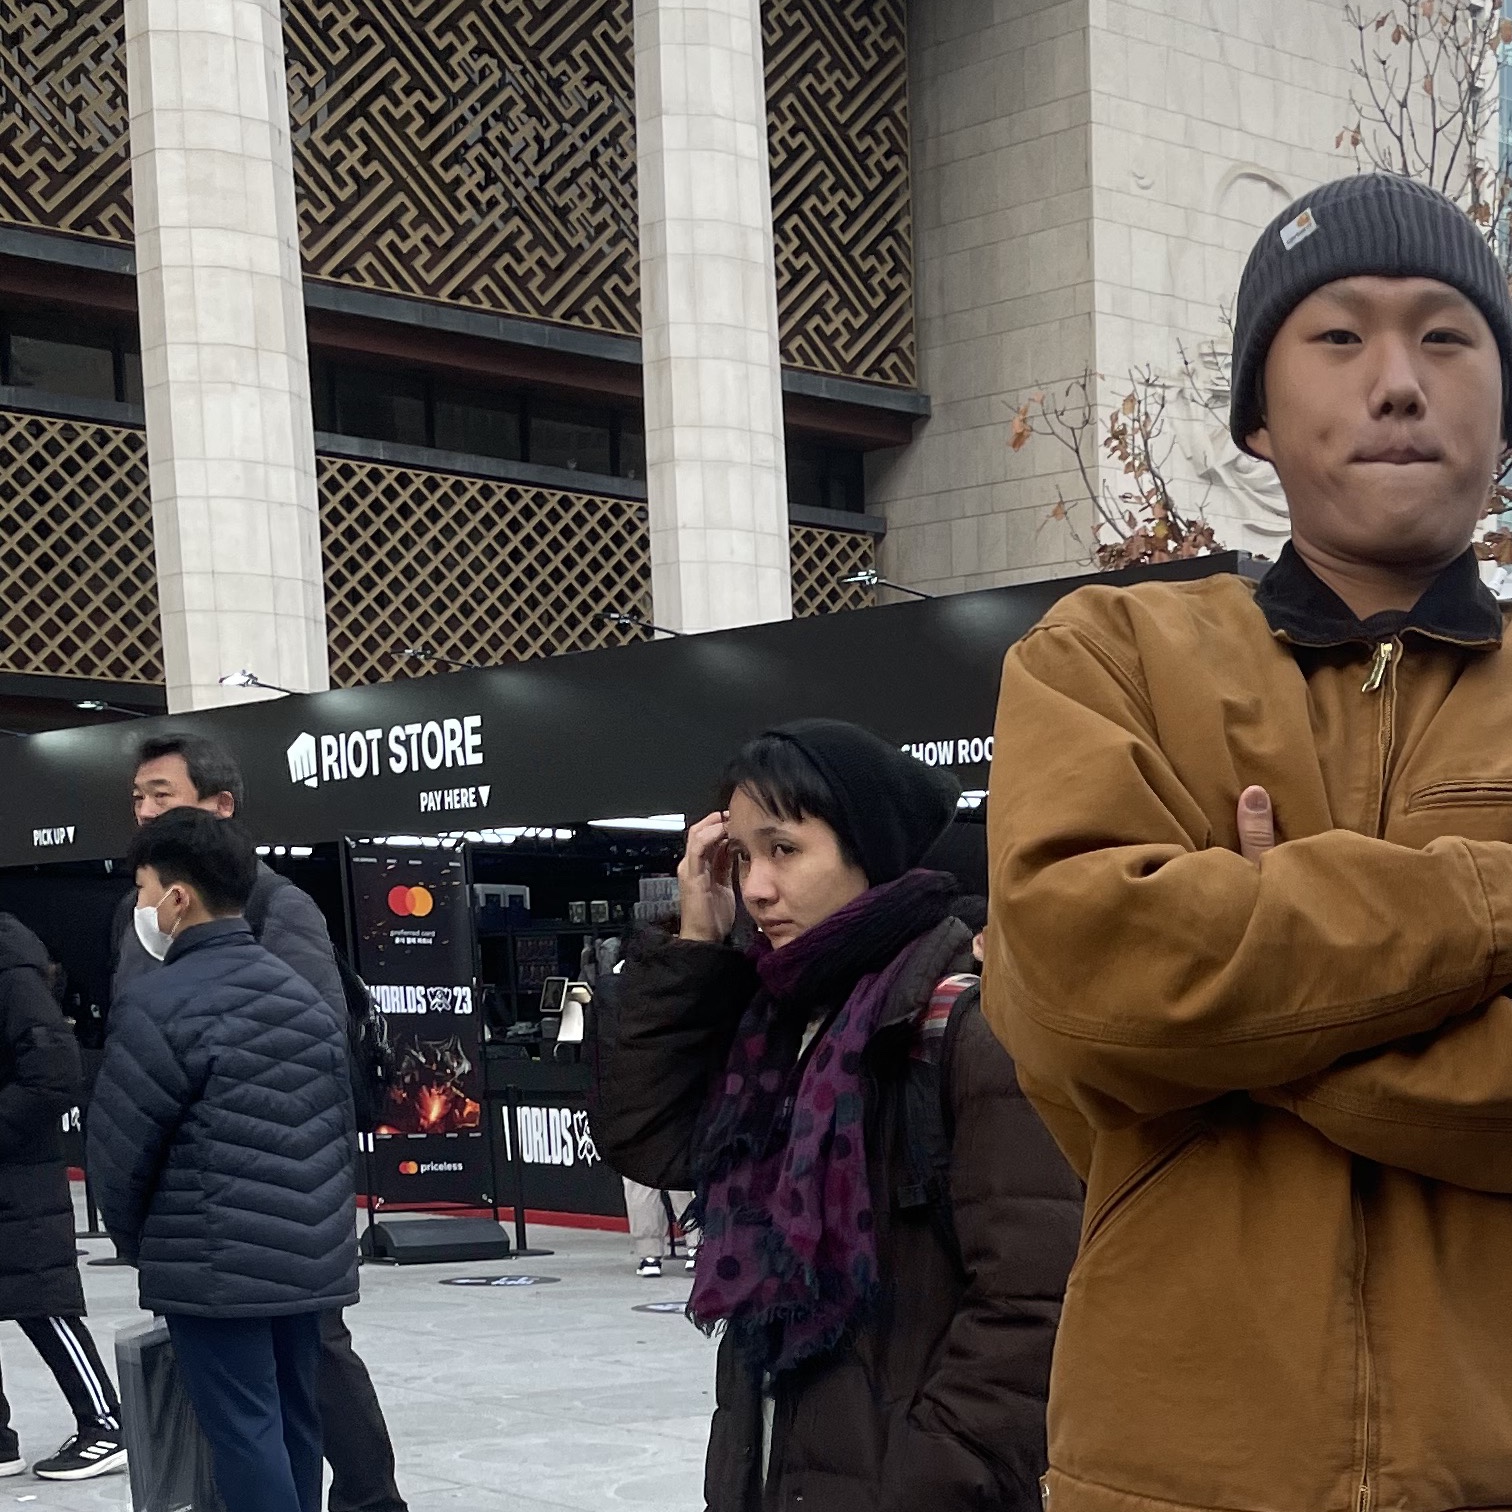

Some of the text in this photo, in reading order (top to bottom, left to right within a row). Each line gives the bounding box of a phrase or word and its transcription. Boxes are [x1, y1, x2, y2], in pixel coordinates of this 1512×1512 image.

[320, 714, 483, 781] RIOT STORE
[419, 787, 478, 813] PAY HERE
[33, 827, 66, 847] PICK UP
[453, 986, 473, 1014] 23
[420, 1161, 464, 1174] priceless
